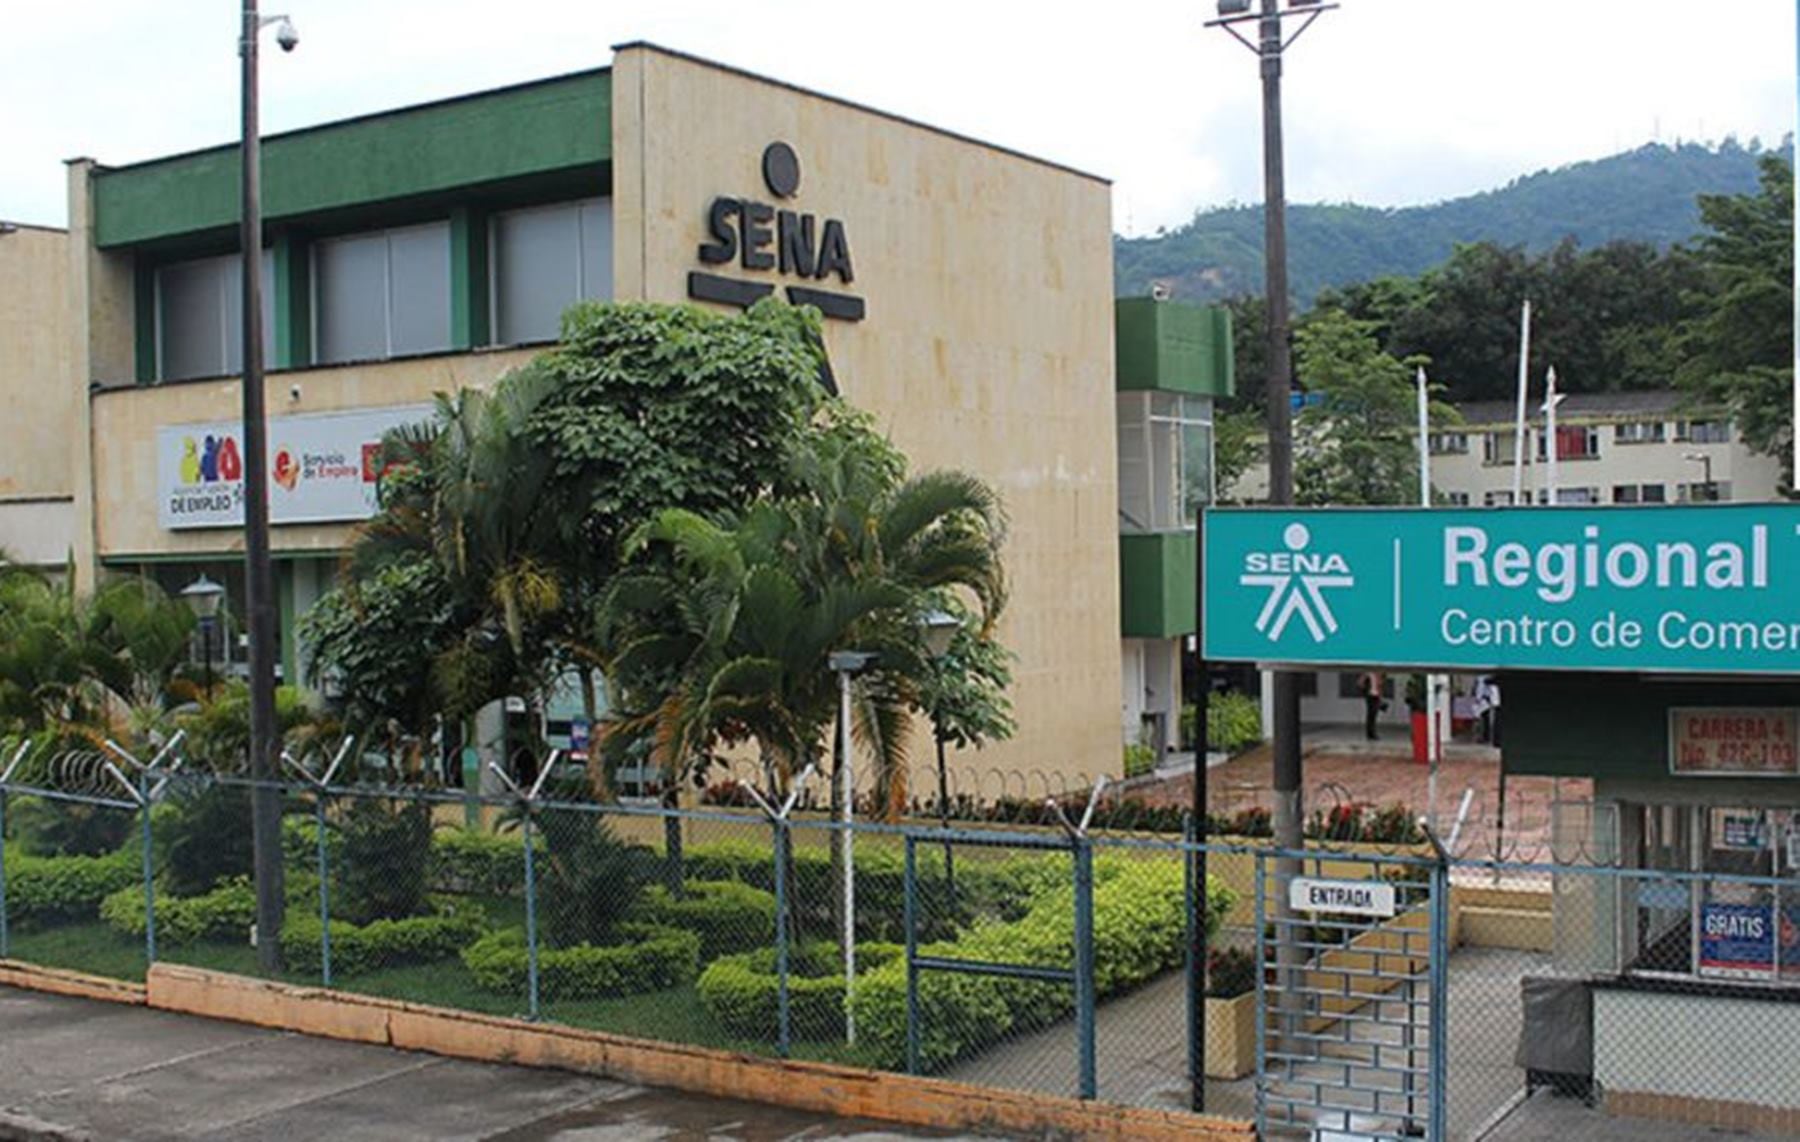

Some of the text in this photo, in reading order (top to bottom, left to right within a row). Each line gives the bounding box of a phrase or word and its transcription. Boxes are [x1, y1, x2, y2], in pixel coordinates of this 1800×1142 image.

[698, 197, 854, 283] SENA
[187, 494, 231, 512] EMPLEO
[1245, 553, 1350, 574] SENA
[1443, 525, 1768, 602] Regional
[1441, 609, 1577, 647] Centro
[1591, 612, 1642, 648] de
[1687, 717, 1768, 740] CARRERA
[1310, 887, 1373, 907] ENTRADA
[1706, 914, 1764, 938] GRATIS
